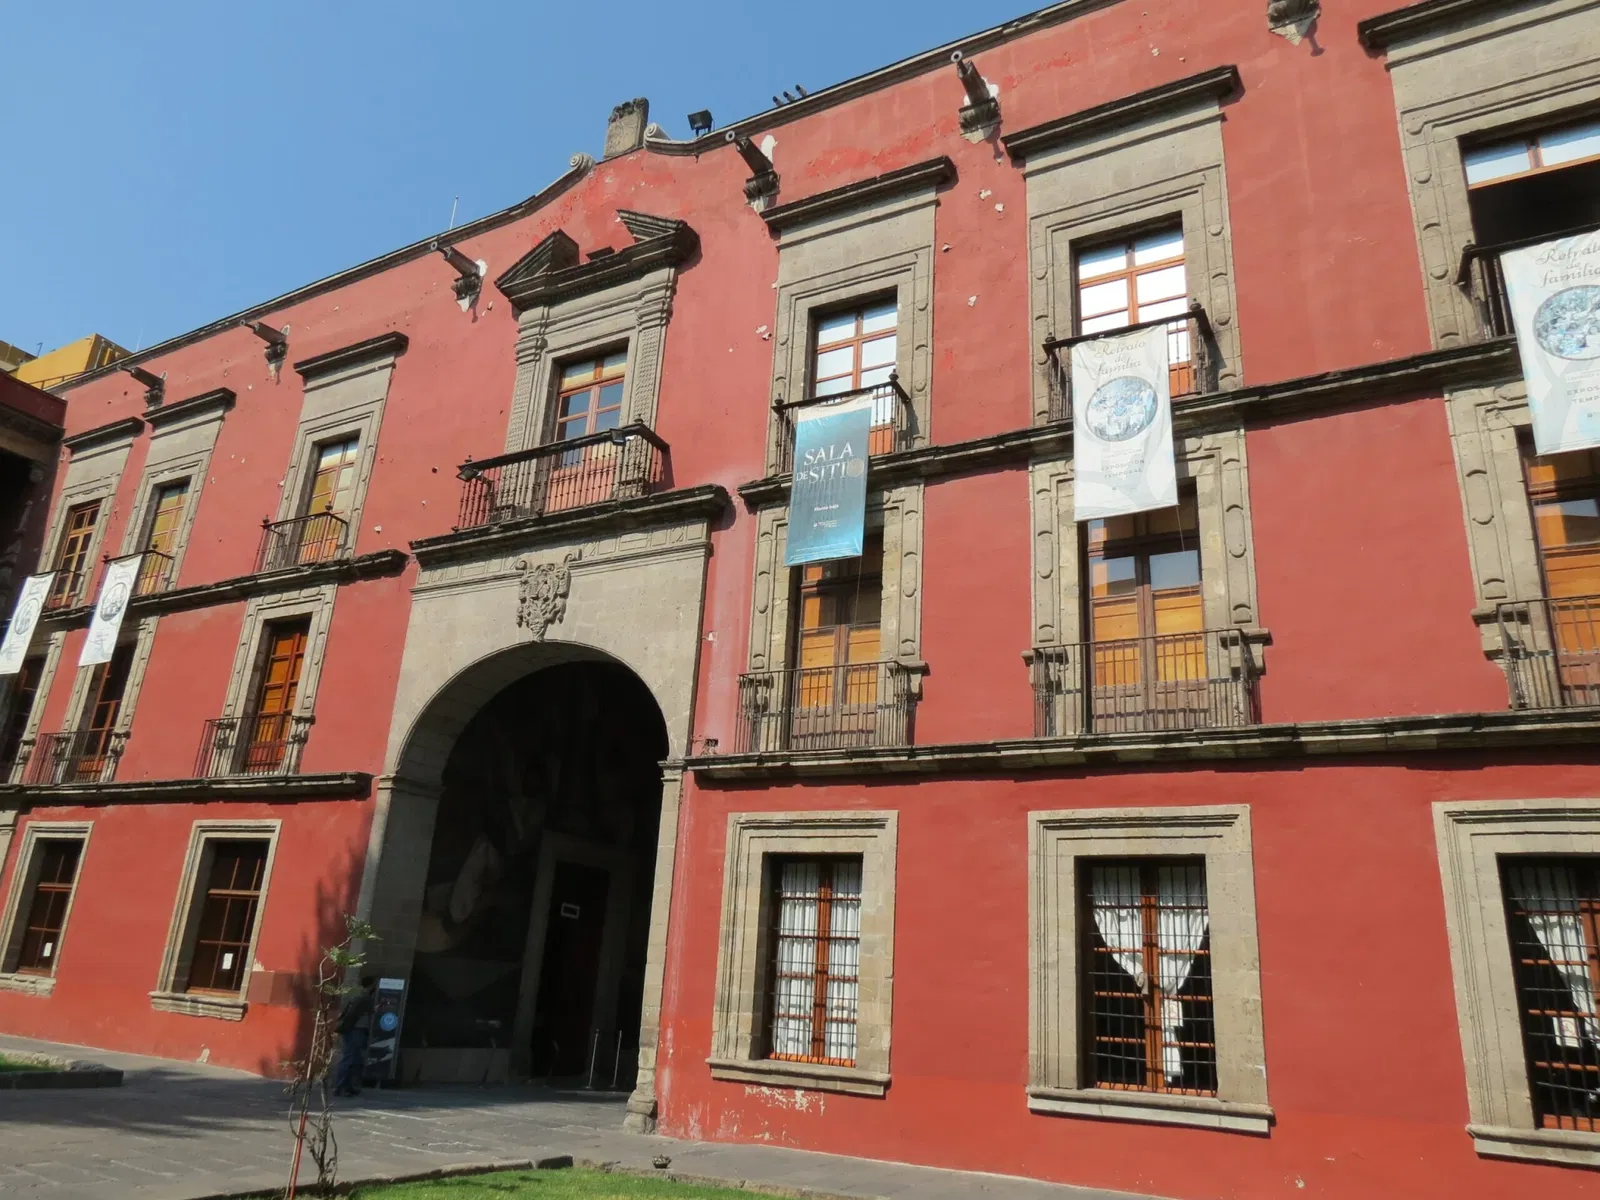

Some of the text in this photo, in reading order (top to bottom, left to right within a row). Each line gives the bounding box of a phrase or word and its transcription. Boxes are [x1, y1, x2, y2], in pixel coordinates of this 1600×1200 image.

[1535, 241, 1600, 265] Retrat
[804, 441, 854, 466] SALA
[796, 470, 809, 481] DE
